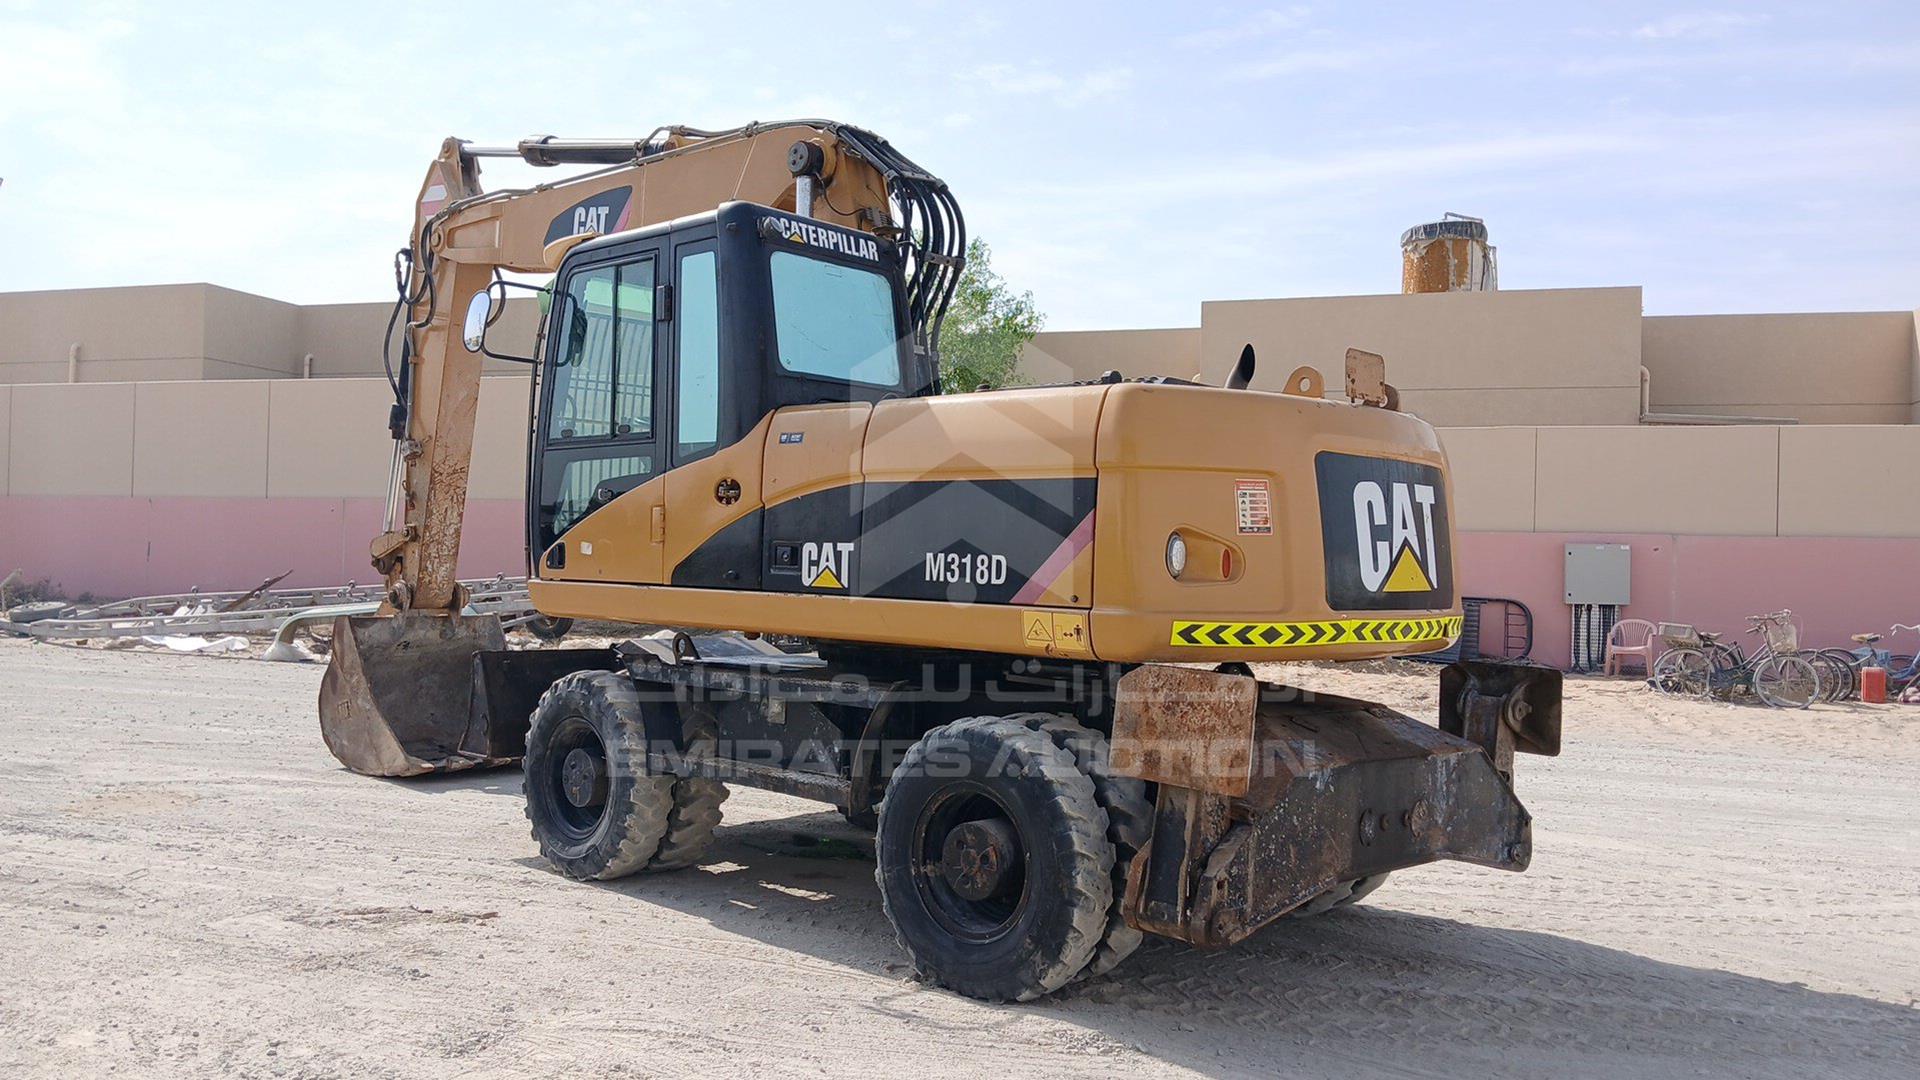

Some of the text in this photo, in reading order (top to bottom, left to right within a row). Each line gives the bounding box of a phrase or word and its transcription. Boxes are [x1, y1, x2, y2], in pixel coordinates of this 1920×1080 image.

[573, 206, 610, 236] CAT
[779, 217, 880, 262] CATERPILLAR
[1353, 481, 1438, 593] CAT
[802, 542, 855, 589] CAT
[924, 551, 1008, 585] M318D
